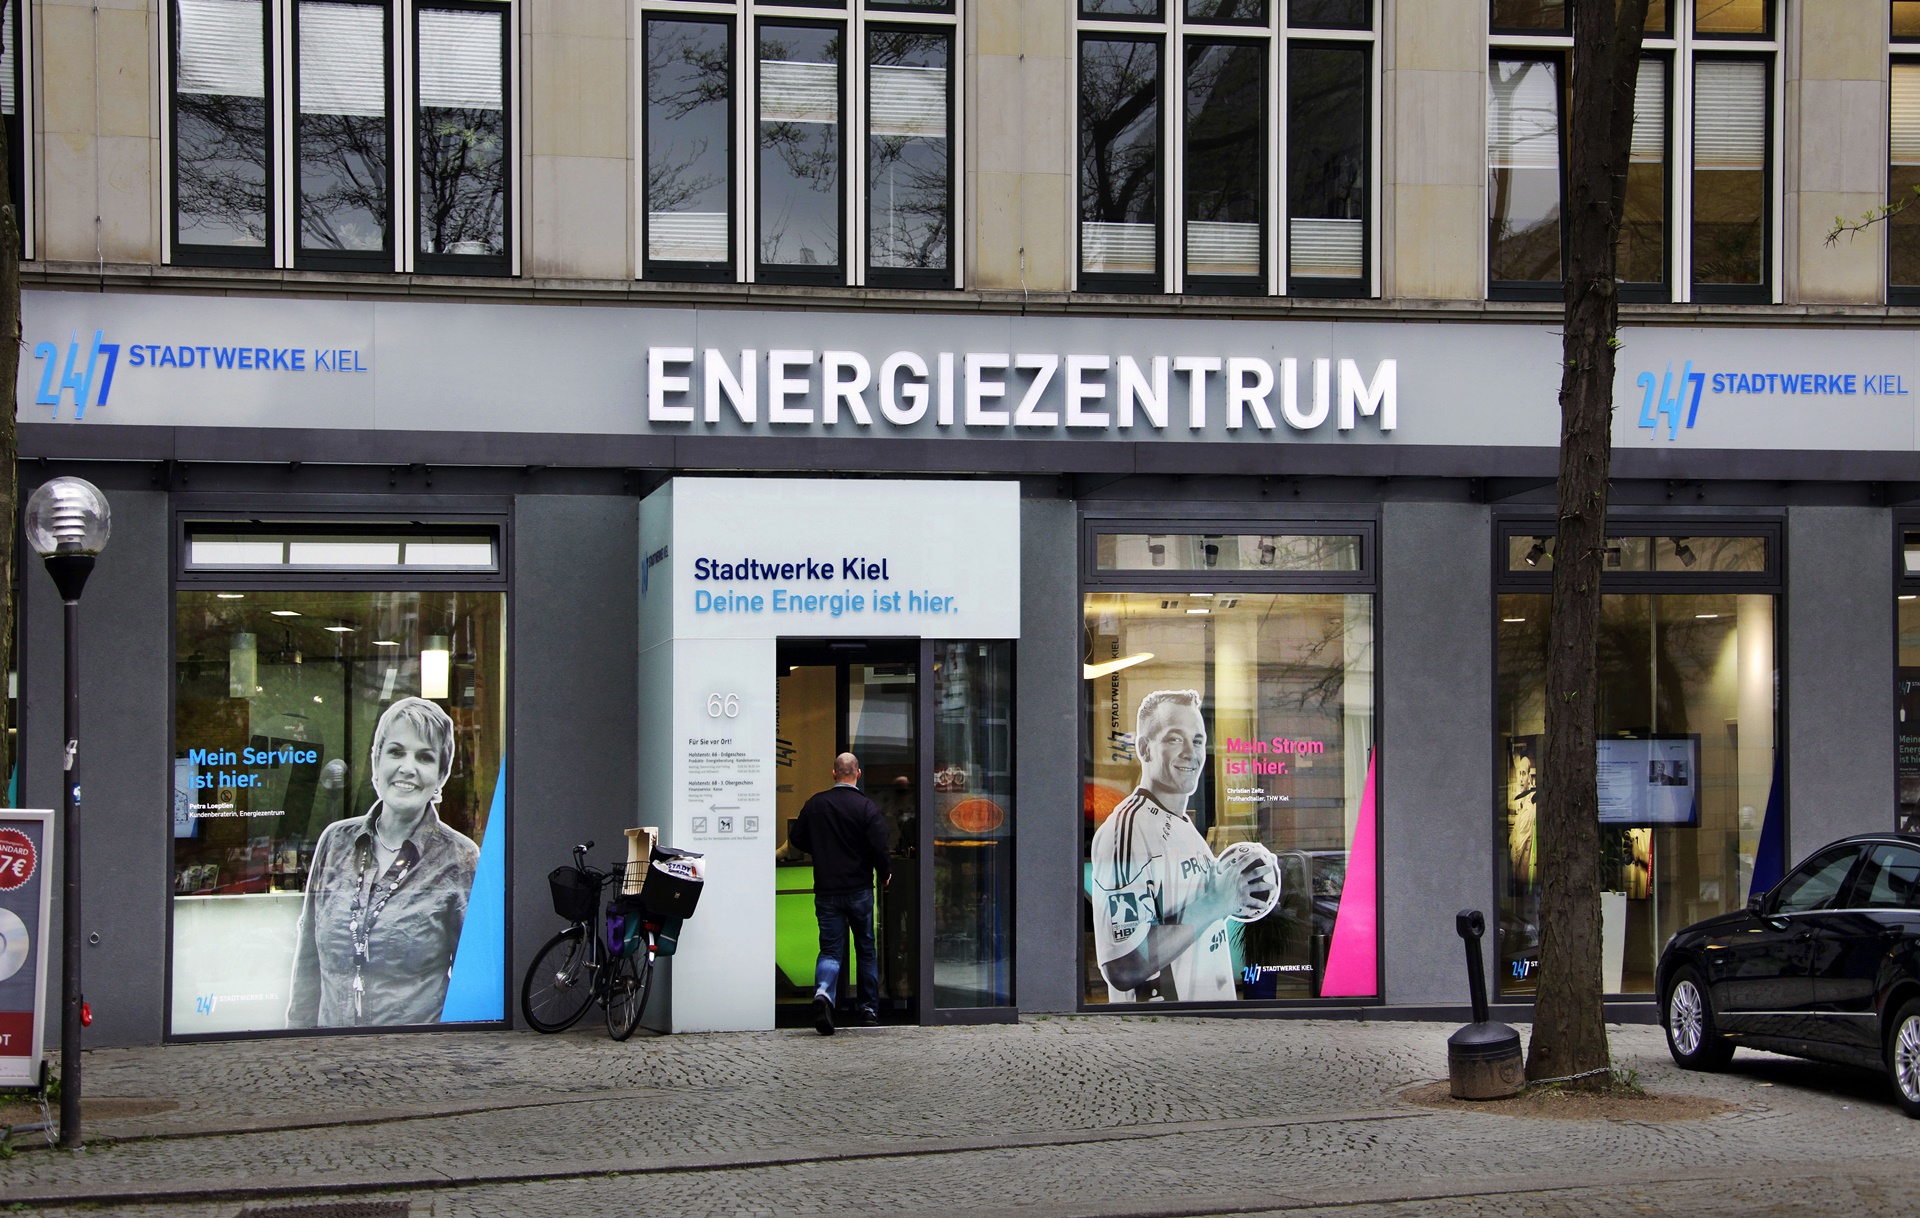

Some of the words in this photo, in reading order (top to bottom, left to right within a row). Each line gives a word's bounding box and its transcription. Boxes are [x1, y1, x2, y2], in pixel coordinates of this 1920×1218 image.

[128, 344, 306, 371] STADTWERKE
[314, 349, 368, 372] KIEL
[647, 346, 1398, 431] ENERGIEZENTRUM
[1712, 373, 1857, 395] STADTWERKE
[1864, 374, 1909, 396] KIEL
[694, 557, 834, 581] Stadtwerke
[842, 557, 890, 580] Kiel
[695, 589, 764, 613] Deine
[772, 588, 865, 618] Energie
[872, 589, 902, 613] ist
[908, 589, 959, 613] hier.
[707, 692, 739, 719] 66
[189, 748, 237, 766] Mein
[242, 746, 318, 765] Service
[1227, 737, 1267, 754] Mein
[1272, 737, 1324, 754] Strom
[1227, 758, 1248, 774] ist
[1252, 757, 1289, 774] hier.
[189, 771, 214, 789] ist
[219, 770, 262, 788] hier.
